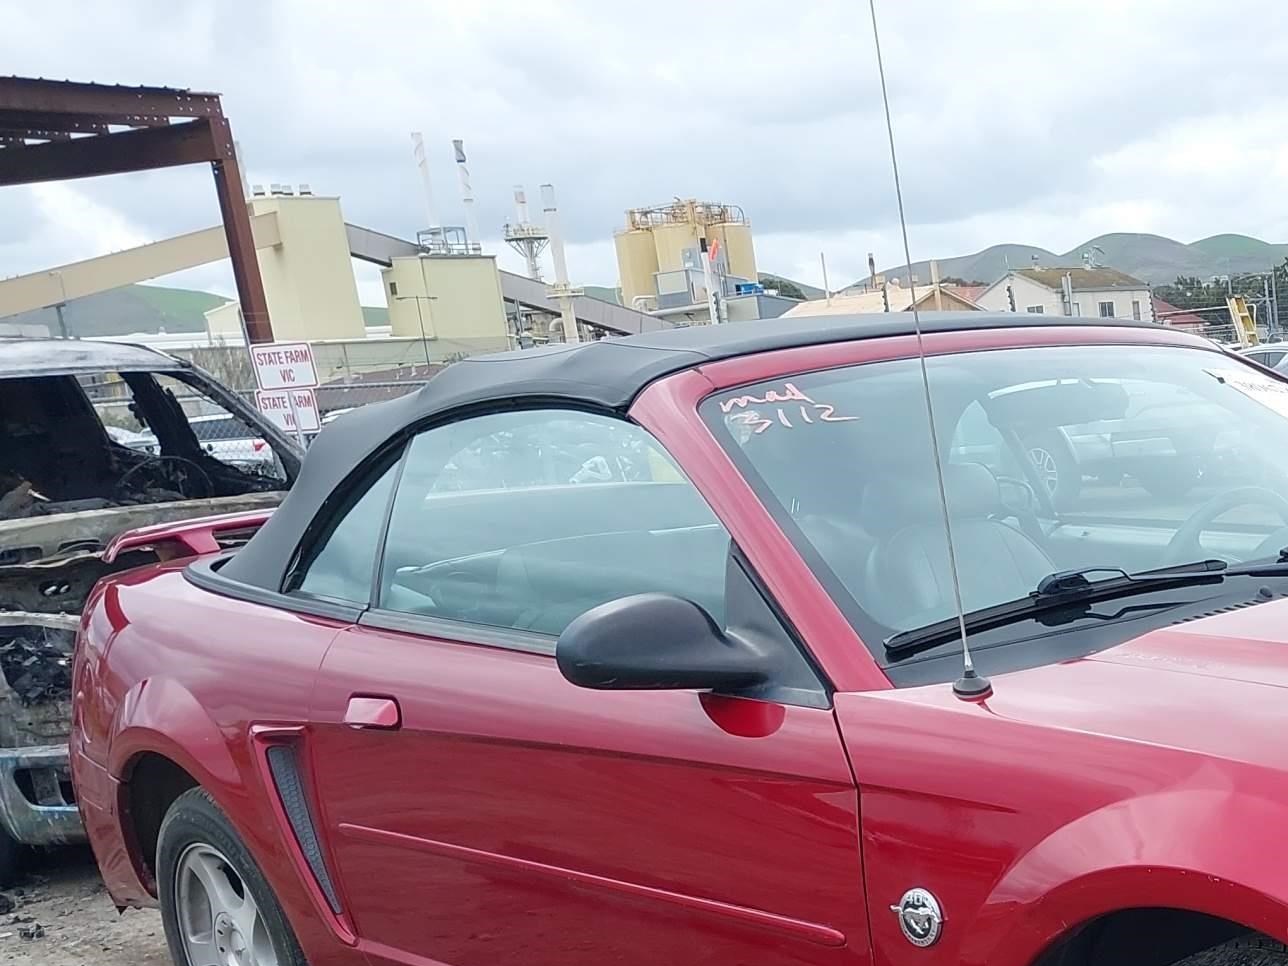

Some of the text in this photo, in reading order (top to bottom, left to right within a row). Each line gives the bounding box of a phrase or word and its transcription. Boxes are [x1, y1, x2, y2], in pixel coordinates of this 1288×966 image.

[256, 349, 310, 366] STATE FARM
[279, 368, 295, 383] VIC
[262, 396, 288, 410] STATE
